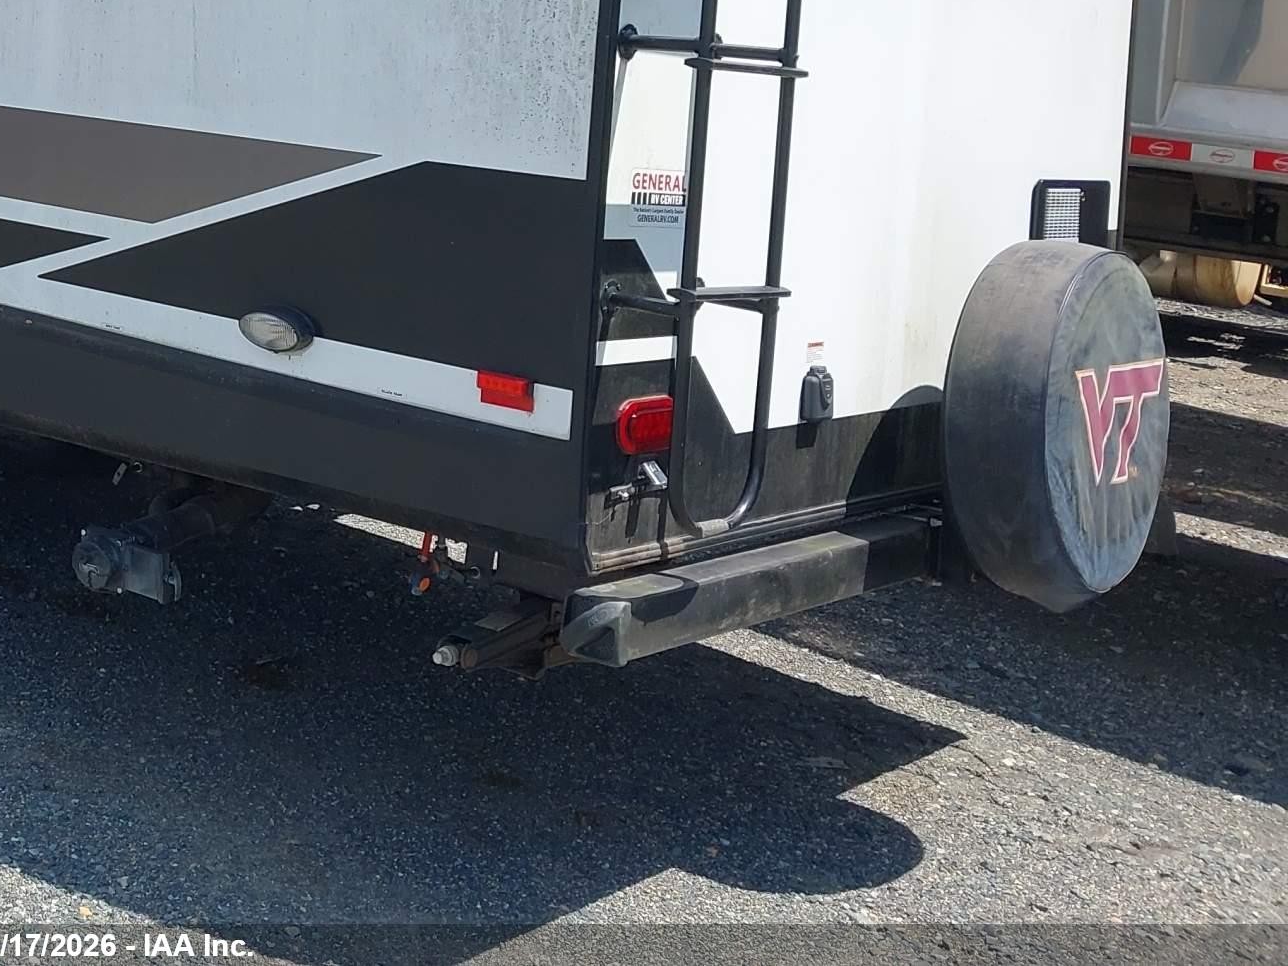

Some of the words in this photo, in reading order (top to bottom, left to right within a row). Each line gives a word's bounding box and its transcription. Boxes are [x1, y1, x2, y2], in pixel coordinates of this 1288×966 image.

[632, 172, 687, 193] GENERAL
[660, 194, 683, 206] CENTER
[1073, 357, 1166, 487] VT
